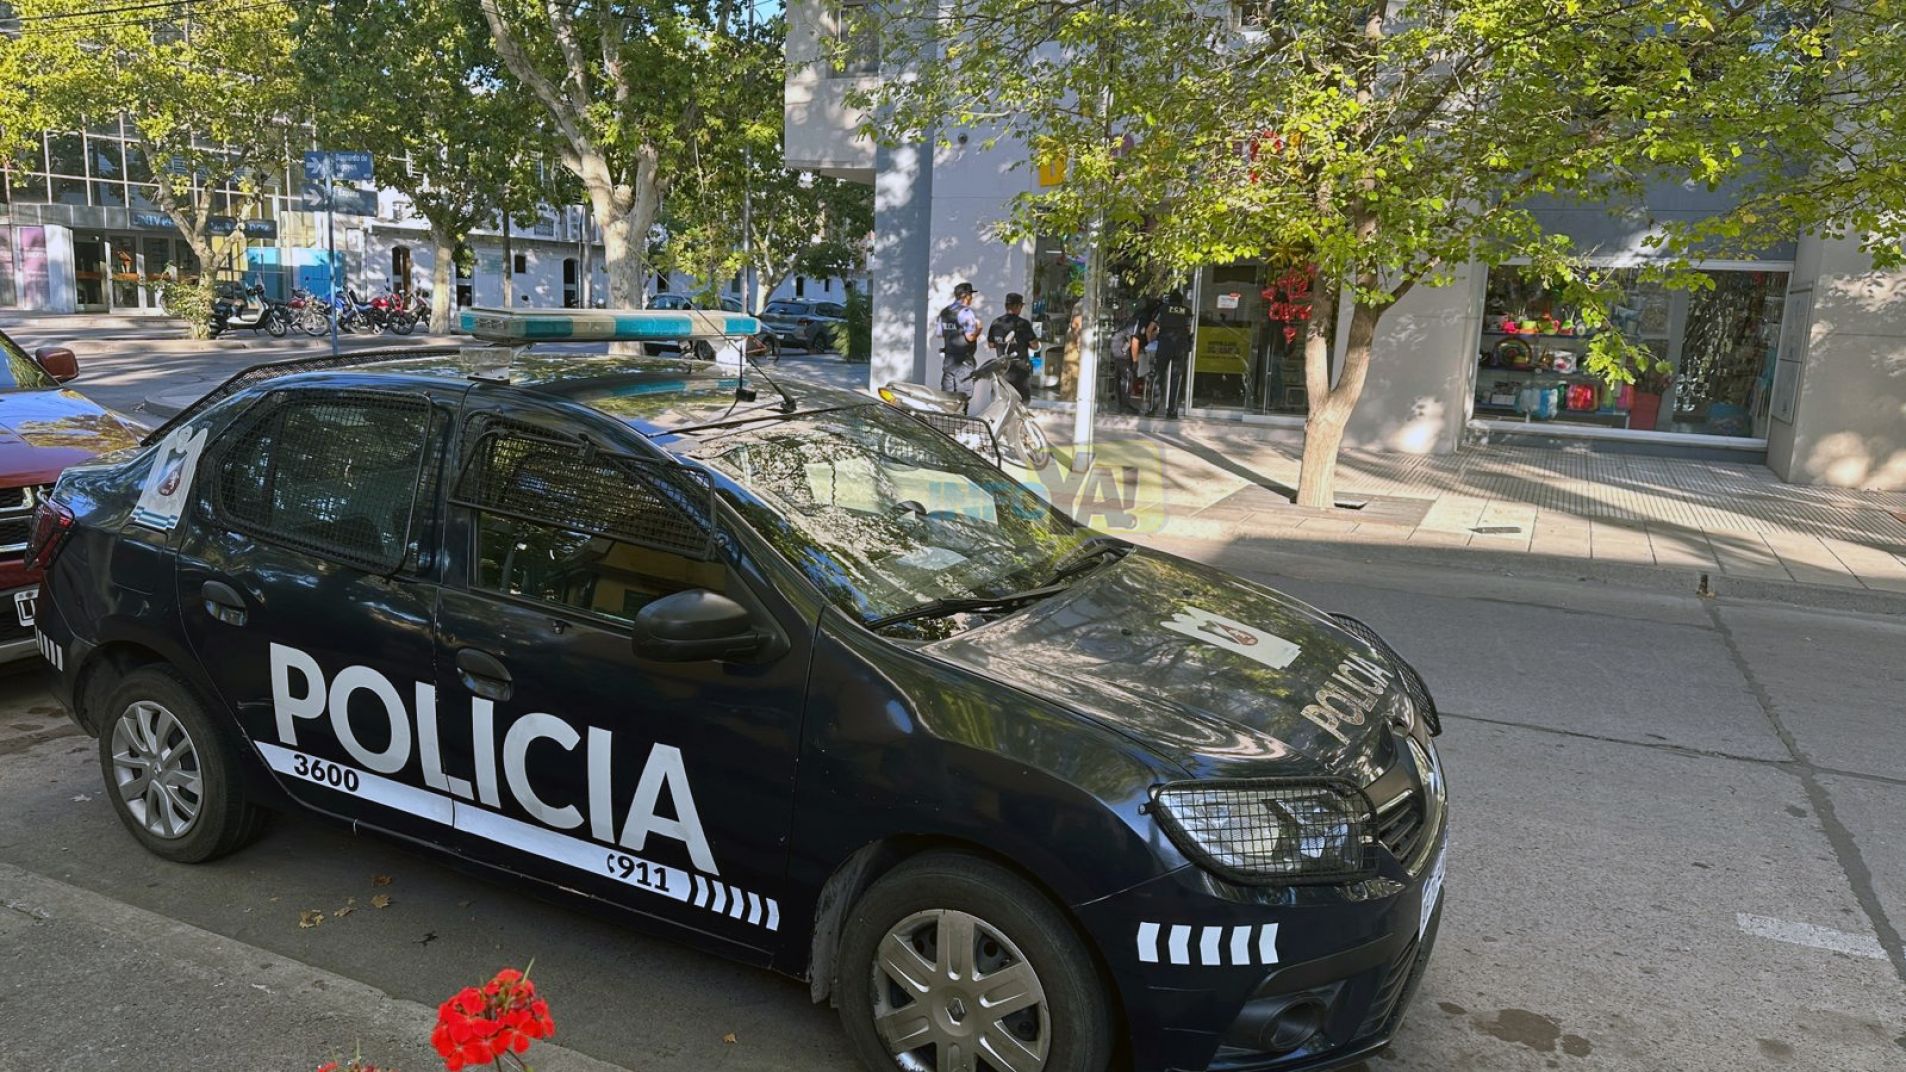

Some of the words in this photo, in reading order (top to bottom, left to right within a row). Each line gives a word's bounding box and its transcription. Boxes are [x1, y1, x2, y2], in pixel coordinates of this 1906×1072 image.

[1300, 651, 1394, 746] POLICIA
[270, 642, 719, 875] POLICIA
[294, 754, 359, 792] 3600
[618, 856, 669, 892] 911
